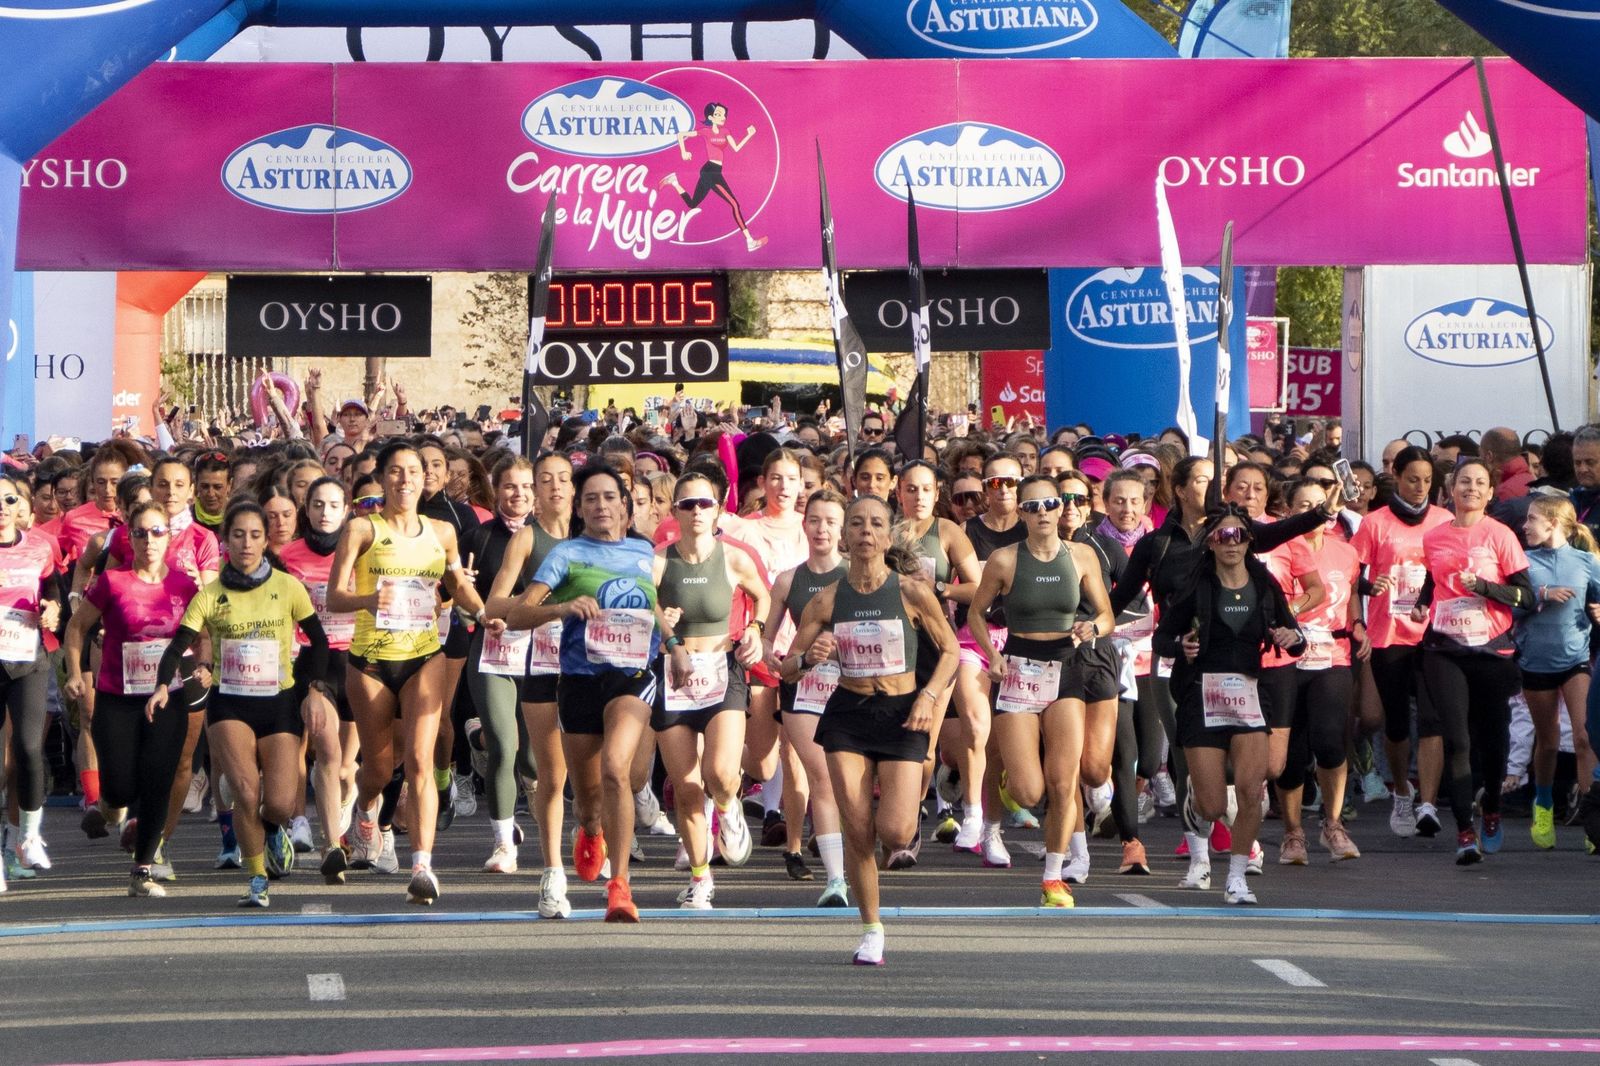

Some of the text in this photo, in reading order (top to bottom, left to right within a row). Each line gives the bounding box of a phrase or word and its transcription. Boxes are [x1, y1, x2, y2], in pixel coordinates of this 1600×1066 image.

[923, 0, 1087, 33] ASTURIANA
[561, 104, 676, 112] CENTRAL LECHERA
[535, 106, 680, 136] ASTURIANA
[266, 155, 391, 164] CENTRAL LECHERA
[236, 156, 398, 189] ASTURIANA
[506, 151, 649, 193] Carrera
[890, 154, 1050, 188] ASTURIANA
[1158, 155, 1306, 187] OYSHO
[573, 194, 593, 225] la
[588, 188, 702, 260] Mujer
[1101, 287, 1161, 300] CENTRAL
[259, 302, 402, 332] OYSHO
[878, 296, 1020, 328] OSHO
[538, 338, 720, 380] OYSHO
[1247, 350, 1275, 360] SHO
[34, 353, 85, 380] HO
[1287, 354, 1332, 375] SUB
[368, 566, 406, 576] AMIGOS
[1036, 575, 1061, 583] OYSHO
[854, 609, 881, 618] OYSHO
[1450, 616, 1472, 627] 016
[607, 633, 632, 644] 016
[856, 644, 883, 655] 016
[238, 663, 261, 674] 016
[686, 676, 709, 688] 016
[1223, 696, 1246, 706] 016
